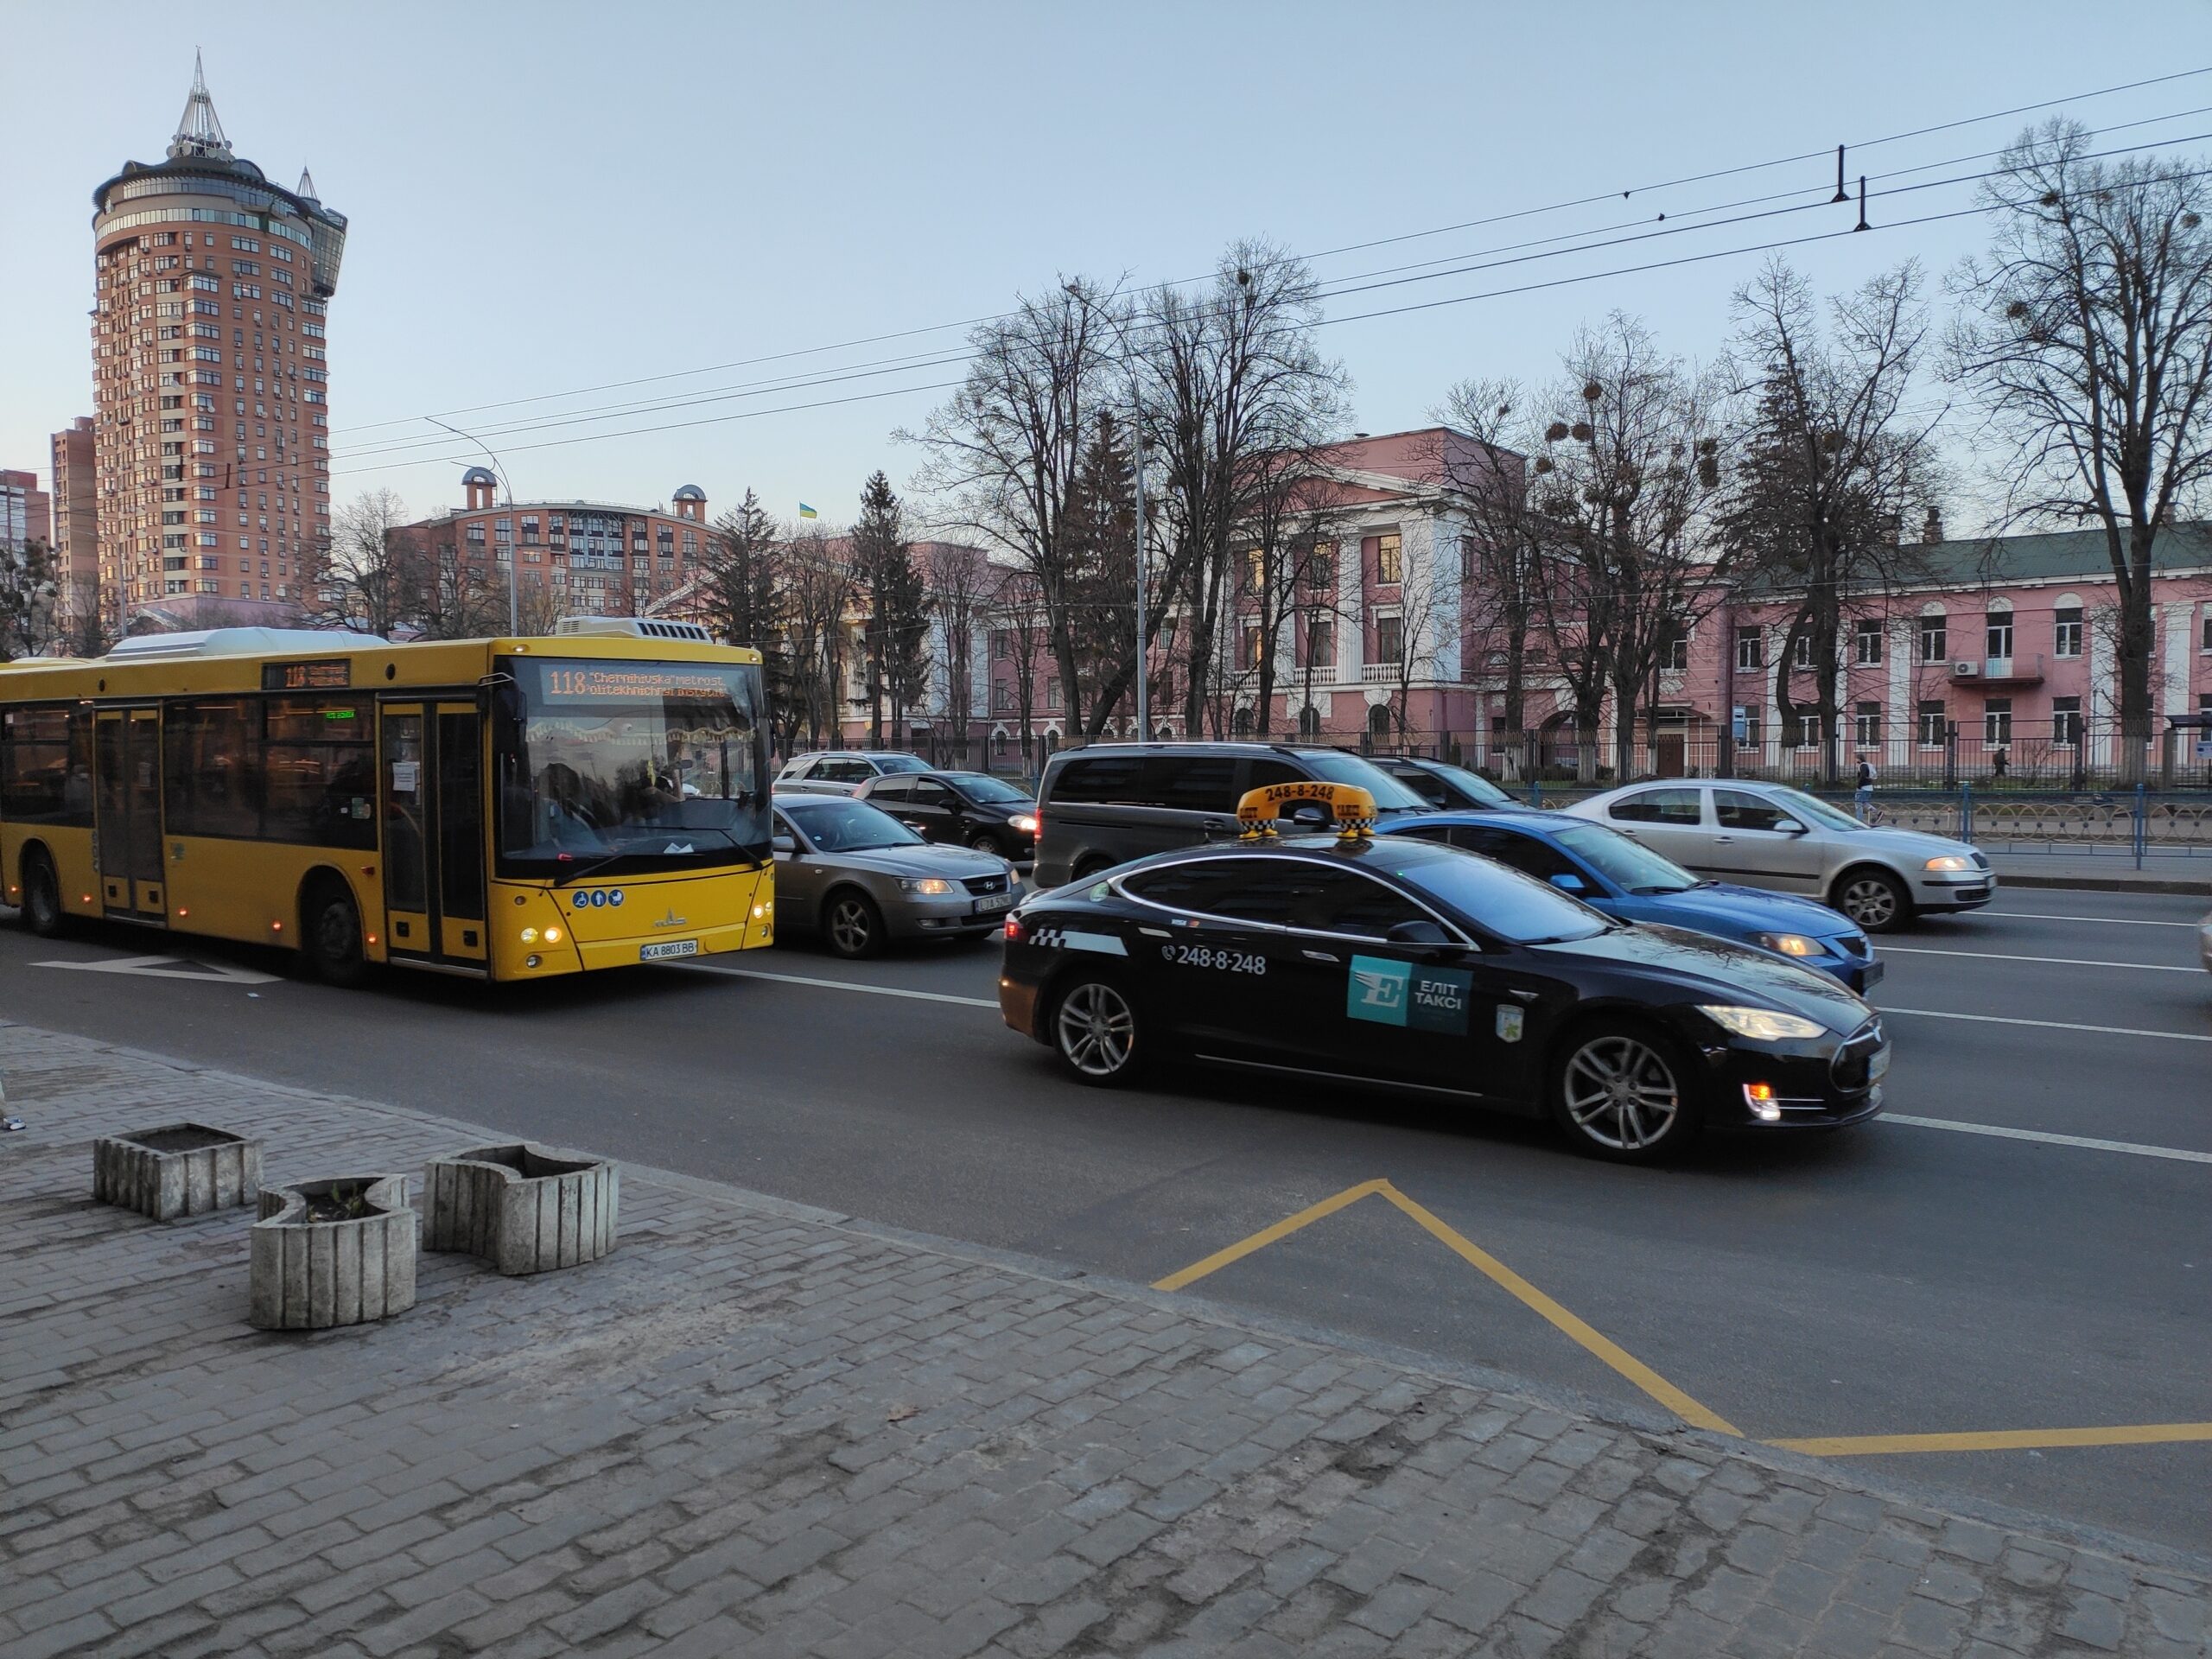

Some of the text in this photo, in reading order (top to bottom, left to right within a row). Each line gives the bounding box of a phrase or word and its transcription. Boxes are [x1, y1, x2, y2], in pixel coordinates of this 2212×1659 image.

[550, 670, 586, 695] 118
[1265, 784, 1336, 802] 248-8-248
[646, 942, 695, 957] KA 8803 BB
[1177, 945, 1267, 976] 248-8-248
[1420, 980, 1459, 995] ЕЛІТ
[1414, 993, 1462, 1009] ТАКСІ
